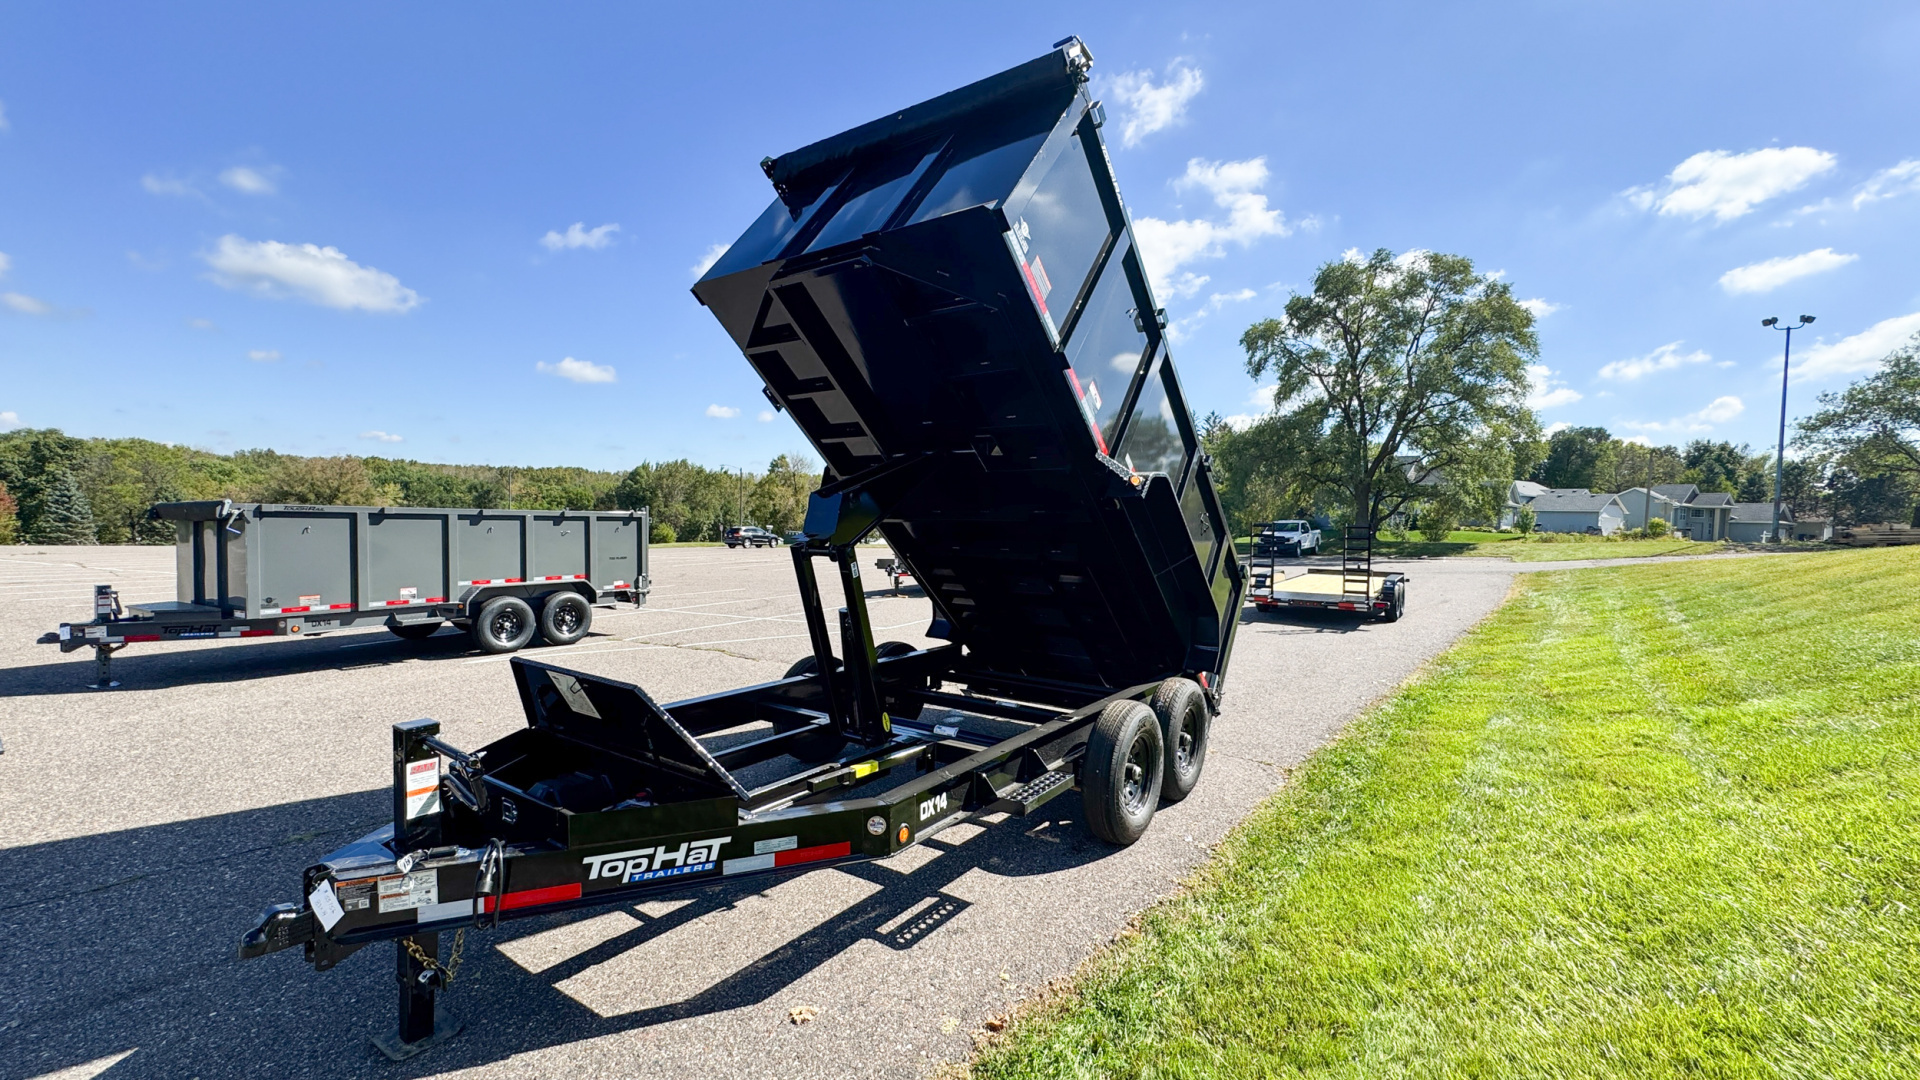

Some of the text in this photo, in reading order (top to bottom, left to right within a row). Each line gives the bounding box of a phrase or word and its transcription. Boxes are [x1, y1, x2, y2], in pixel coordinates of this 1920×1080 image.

[311, 619, 332, 628] DX14
[919, 792, 948, 822] DX14
[632, 862, 714, 881] TRAILERS
